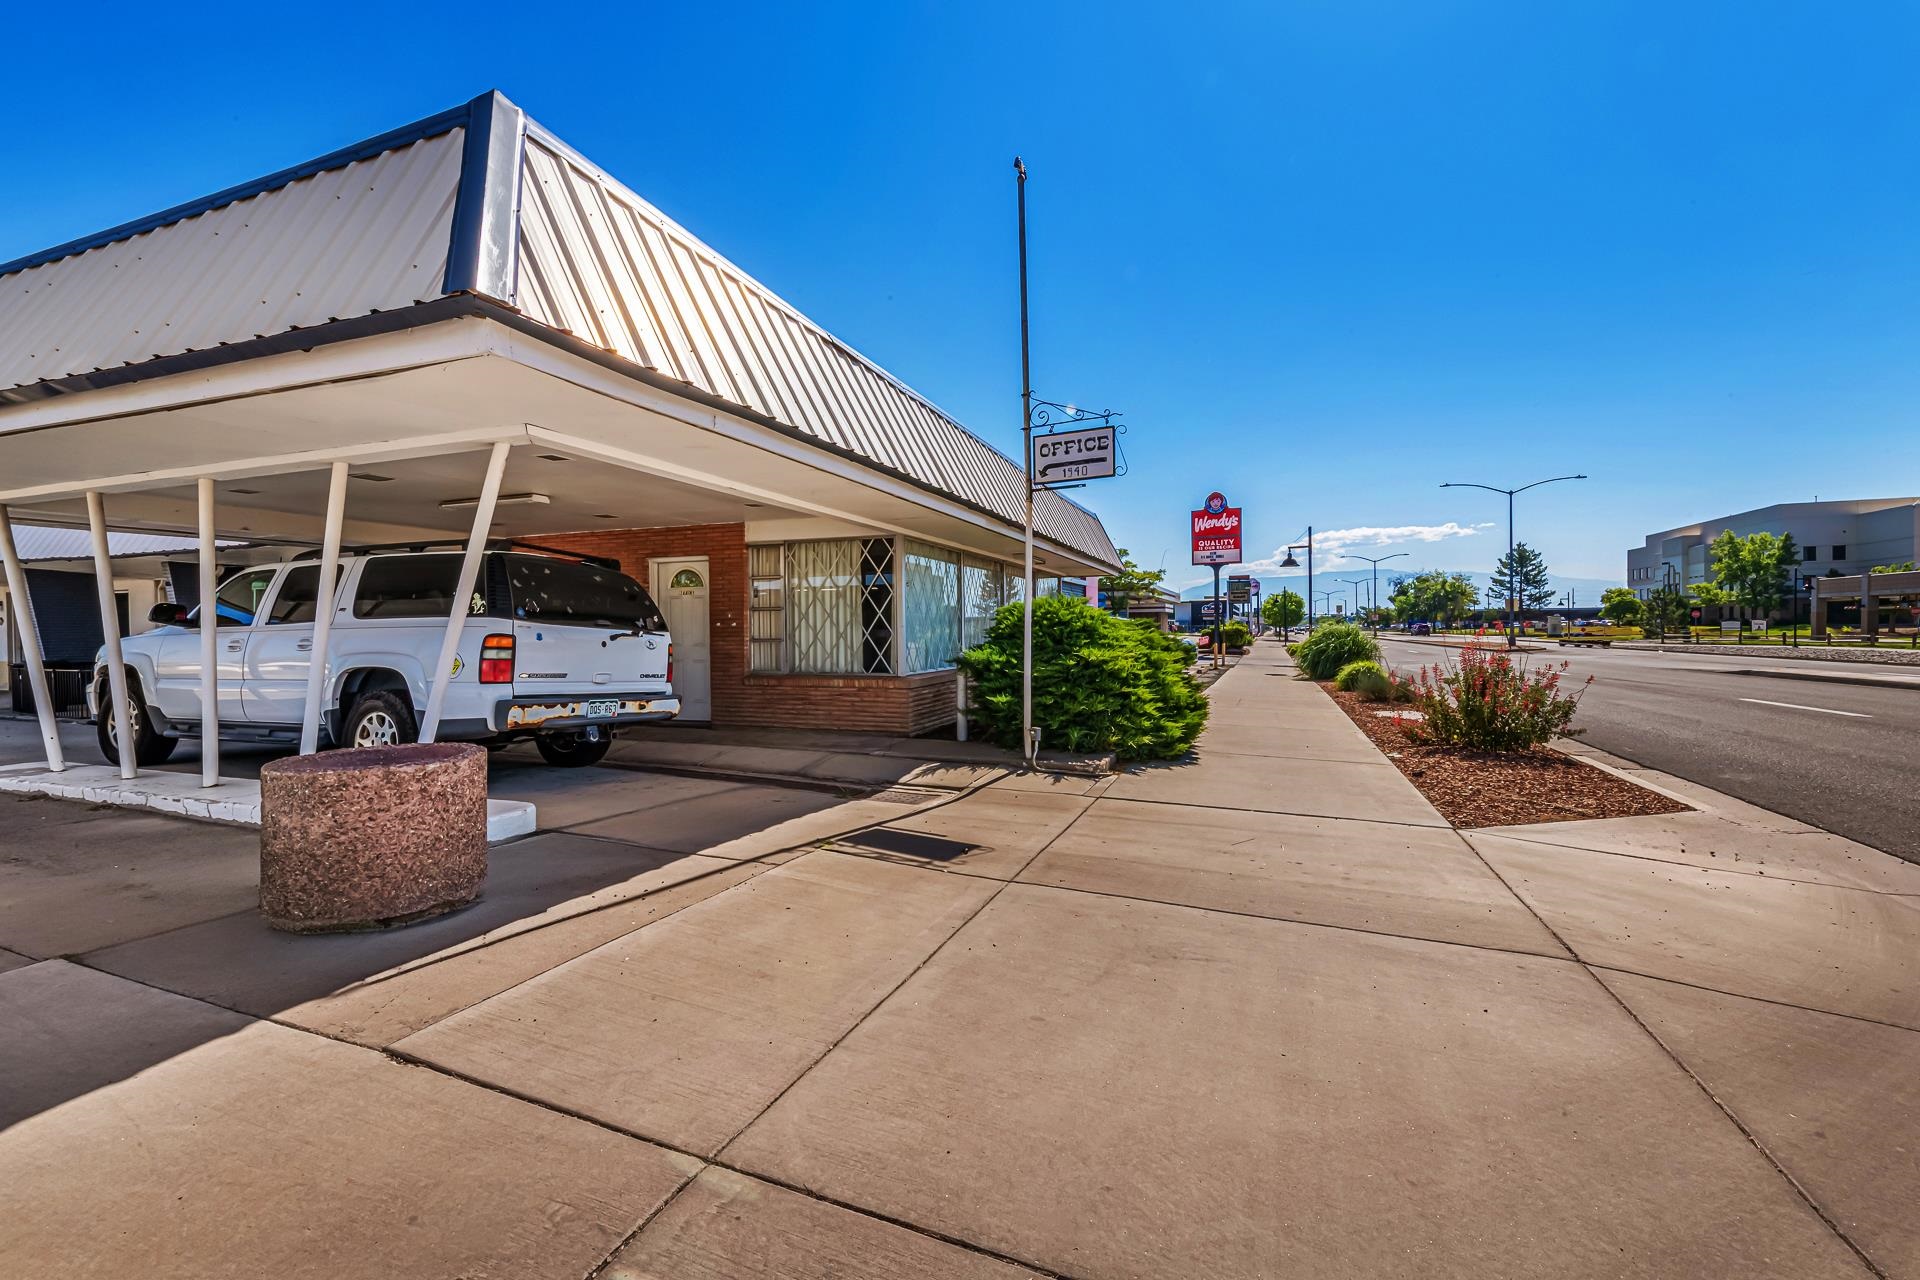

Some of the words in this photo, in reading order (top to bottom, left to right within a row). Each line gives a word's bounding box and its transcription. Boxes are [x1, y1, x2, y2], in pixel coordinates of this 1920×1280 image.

[1040, 436, 1109, 457] OFFICE
[1194, 513, 1239, 533] Wendy's
[1198, 539, 1235, 547] QUALITY
